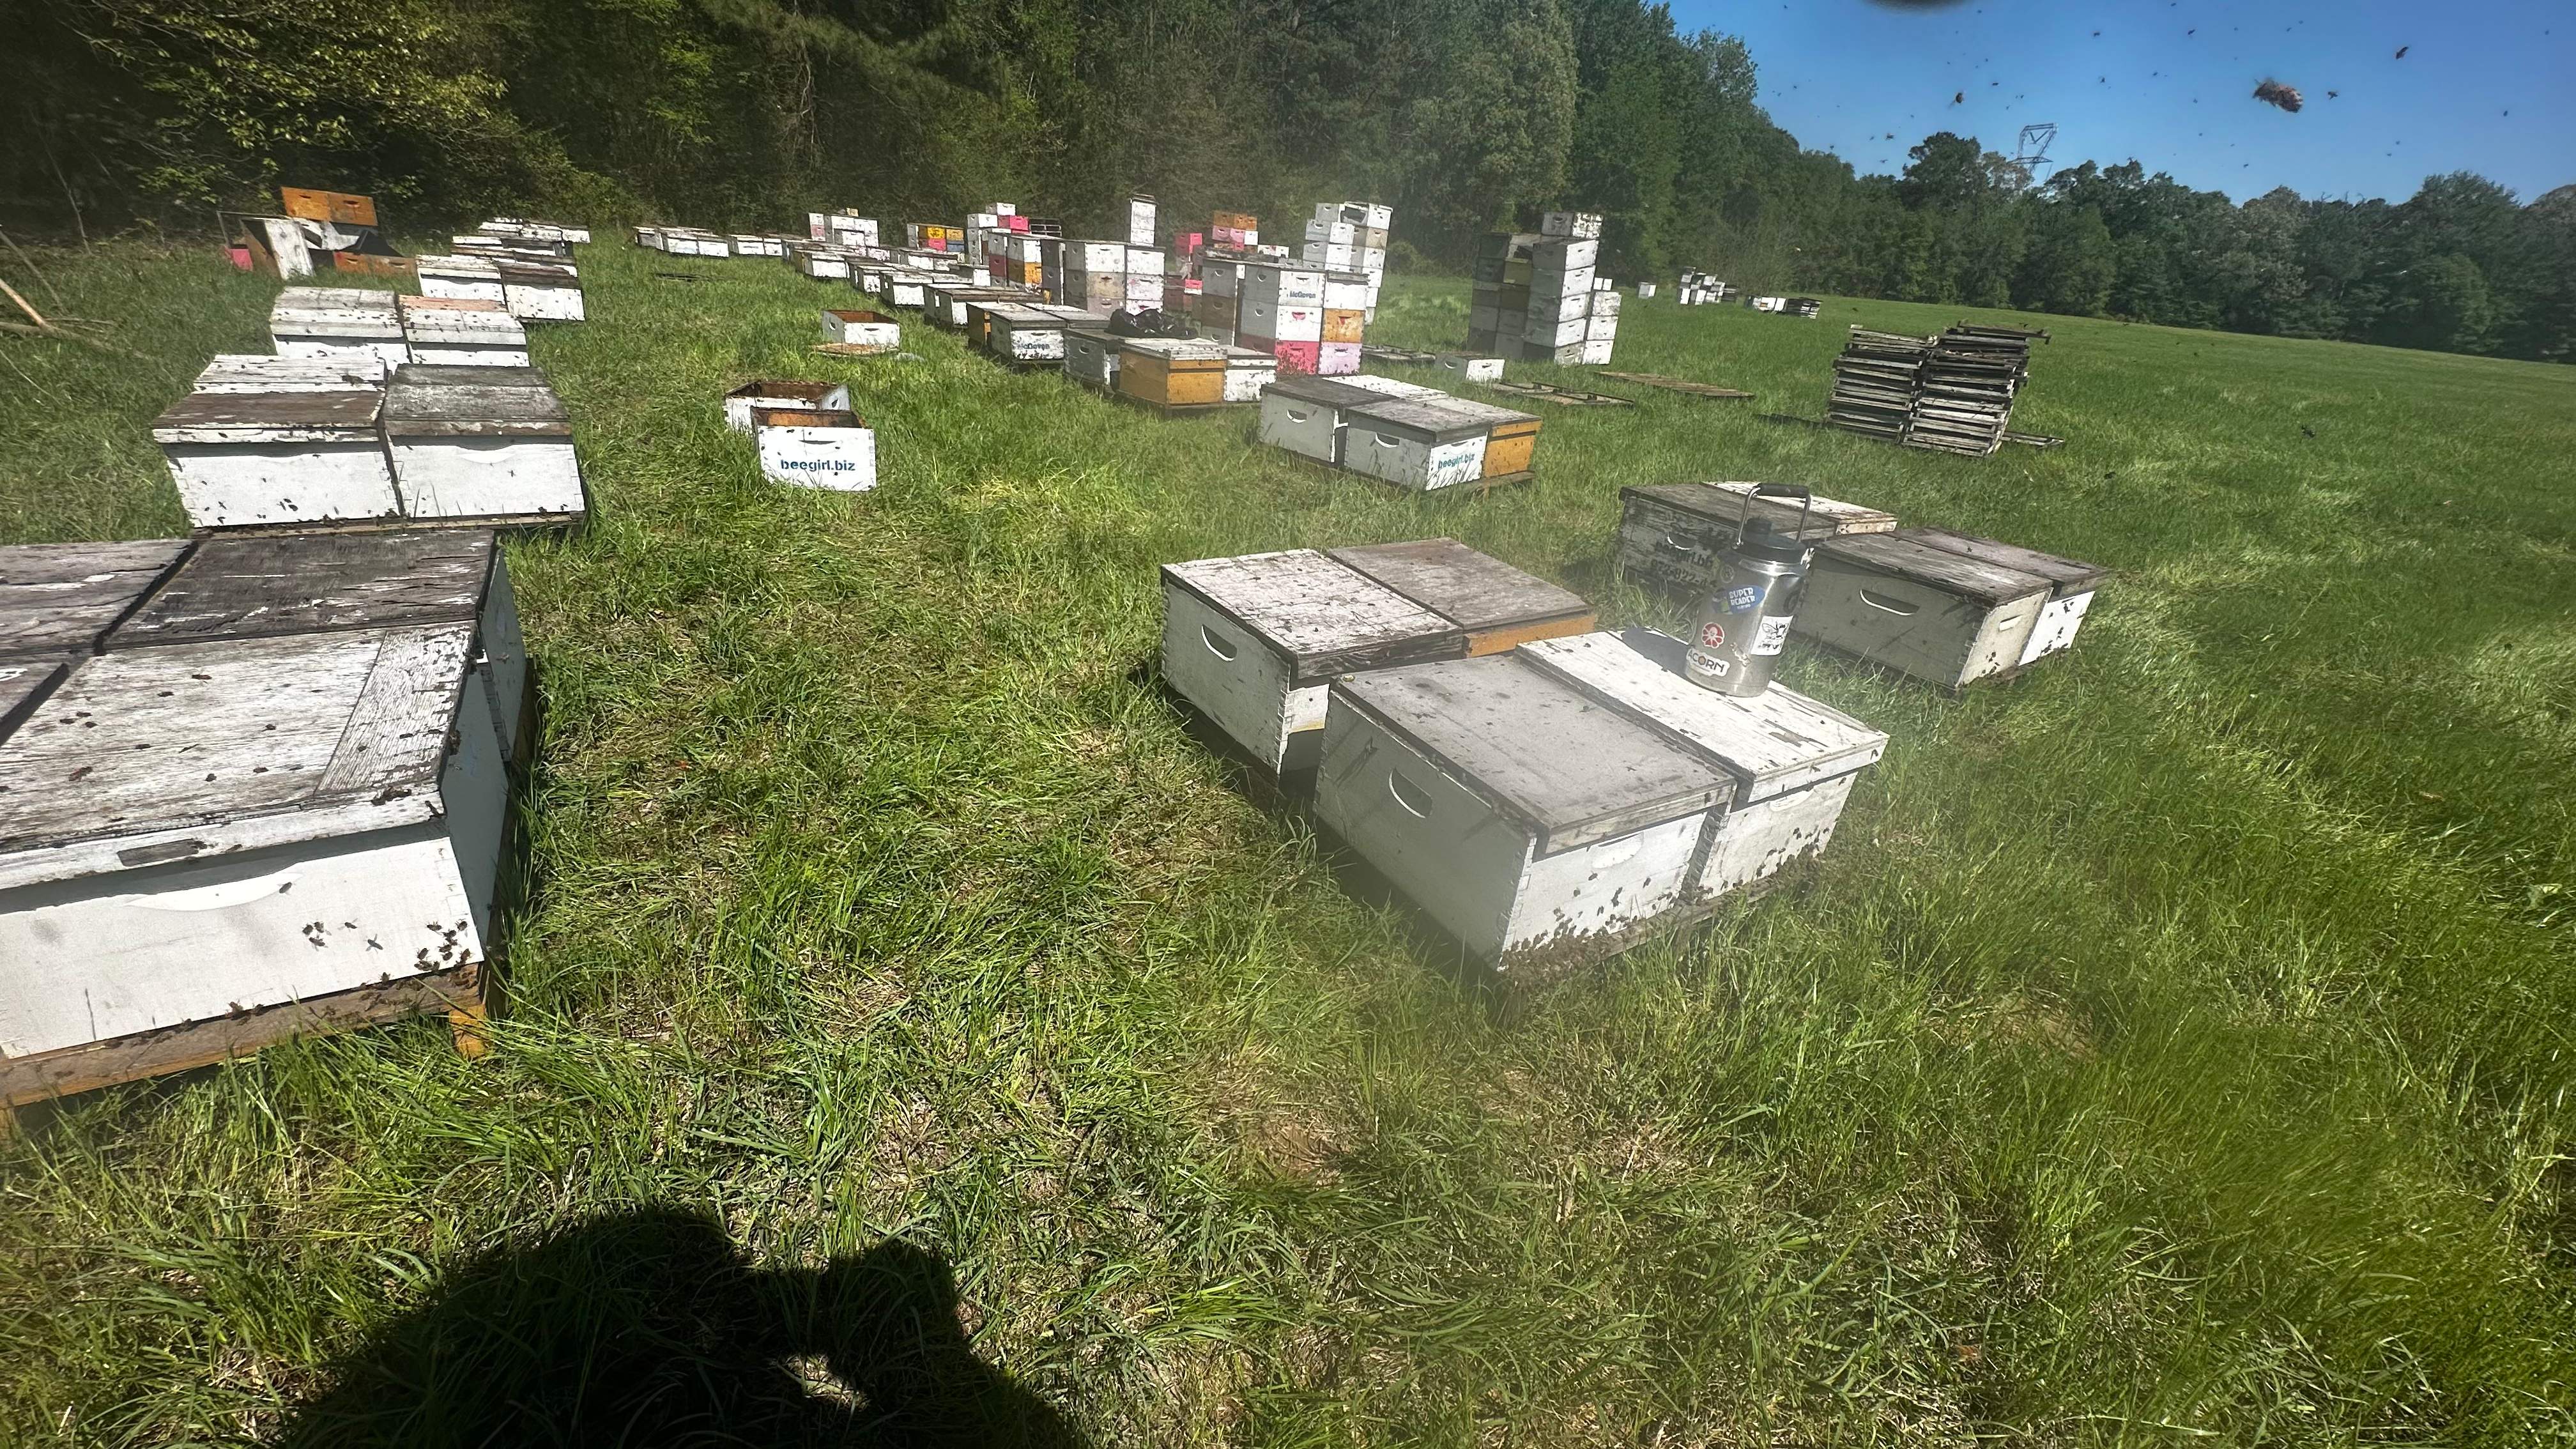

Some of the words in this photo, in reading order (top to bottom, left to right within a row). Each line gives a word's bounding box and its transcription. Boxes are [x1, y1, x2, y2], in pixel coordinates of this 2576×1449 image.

[781, 459, 855, 471] beegirl.biz
[1728, 587, 1754, 599] SUPER
[1730, 595, 1756, 606] READER
[1688, 649, 1725, 673] ACORN
